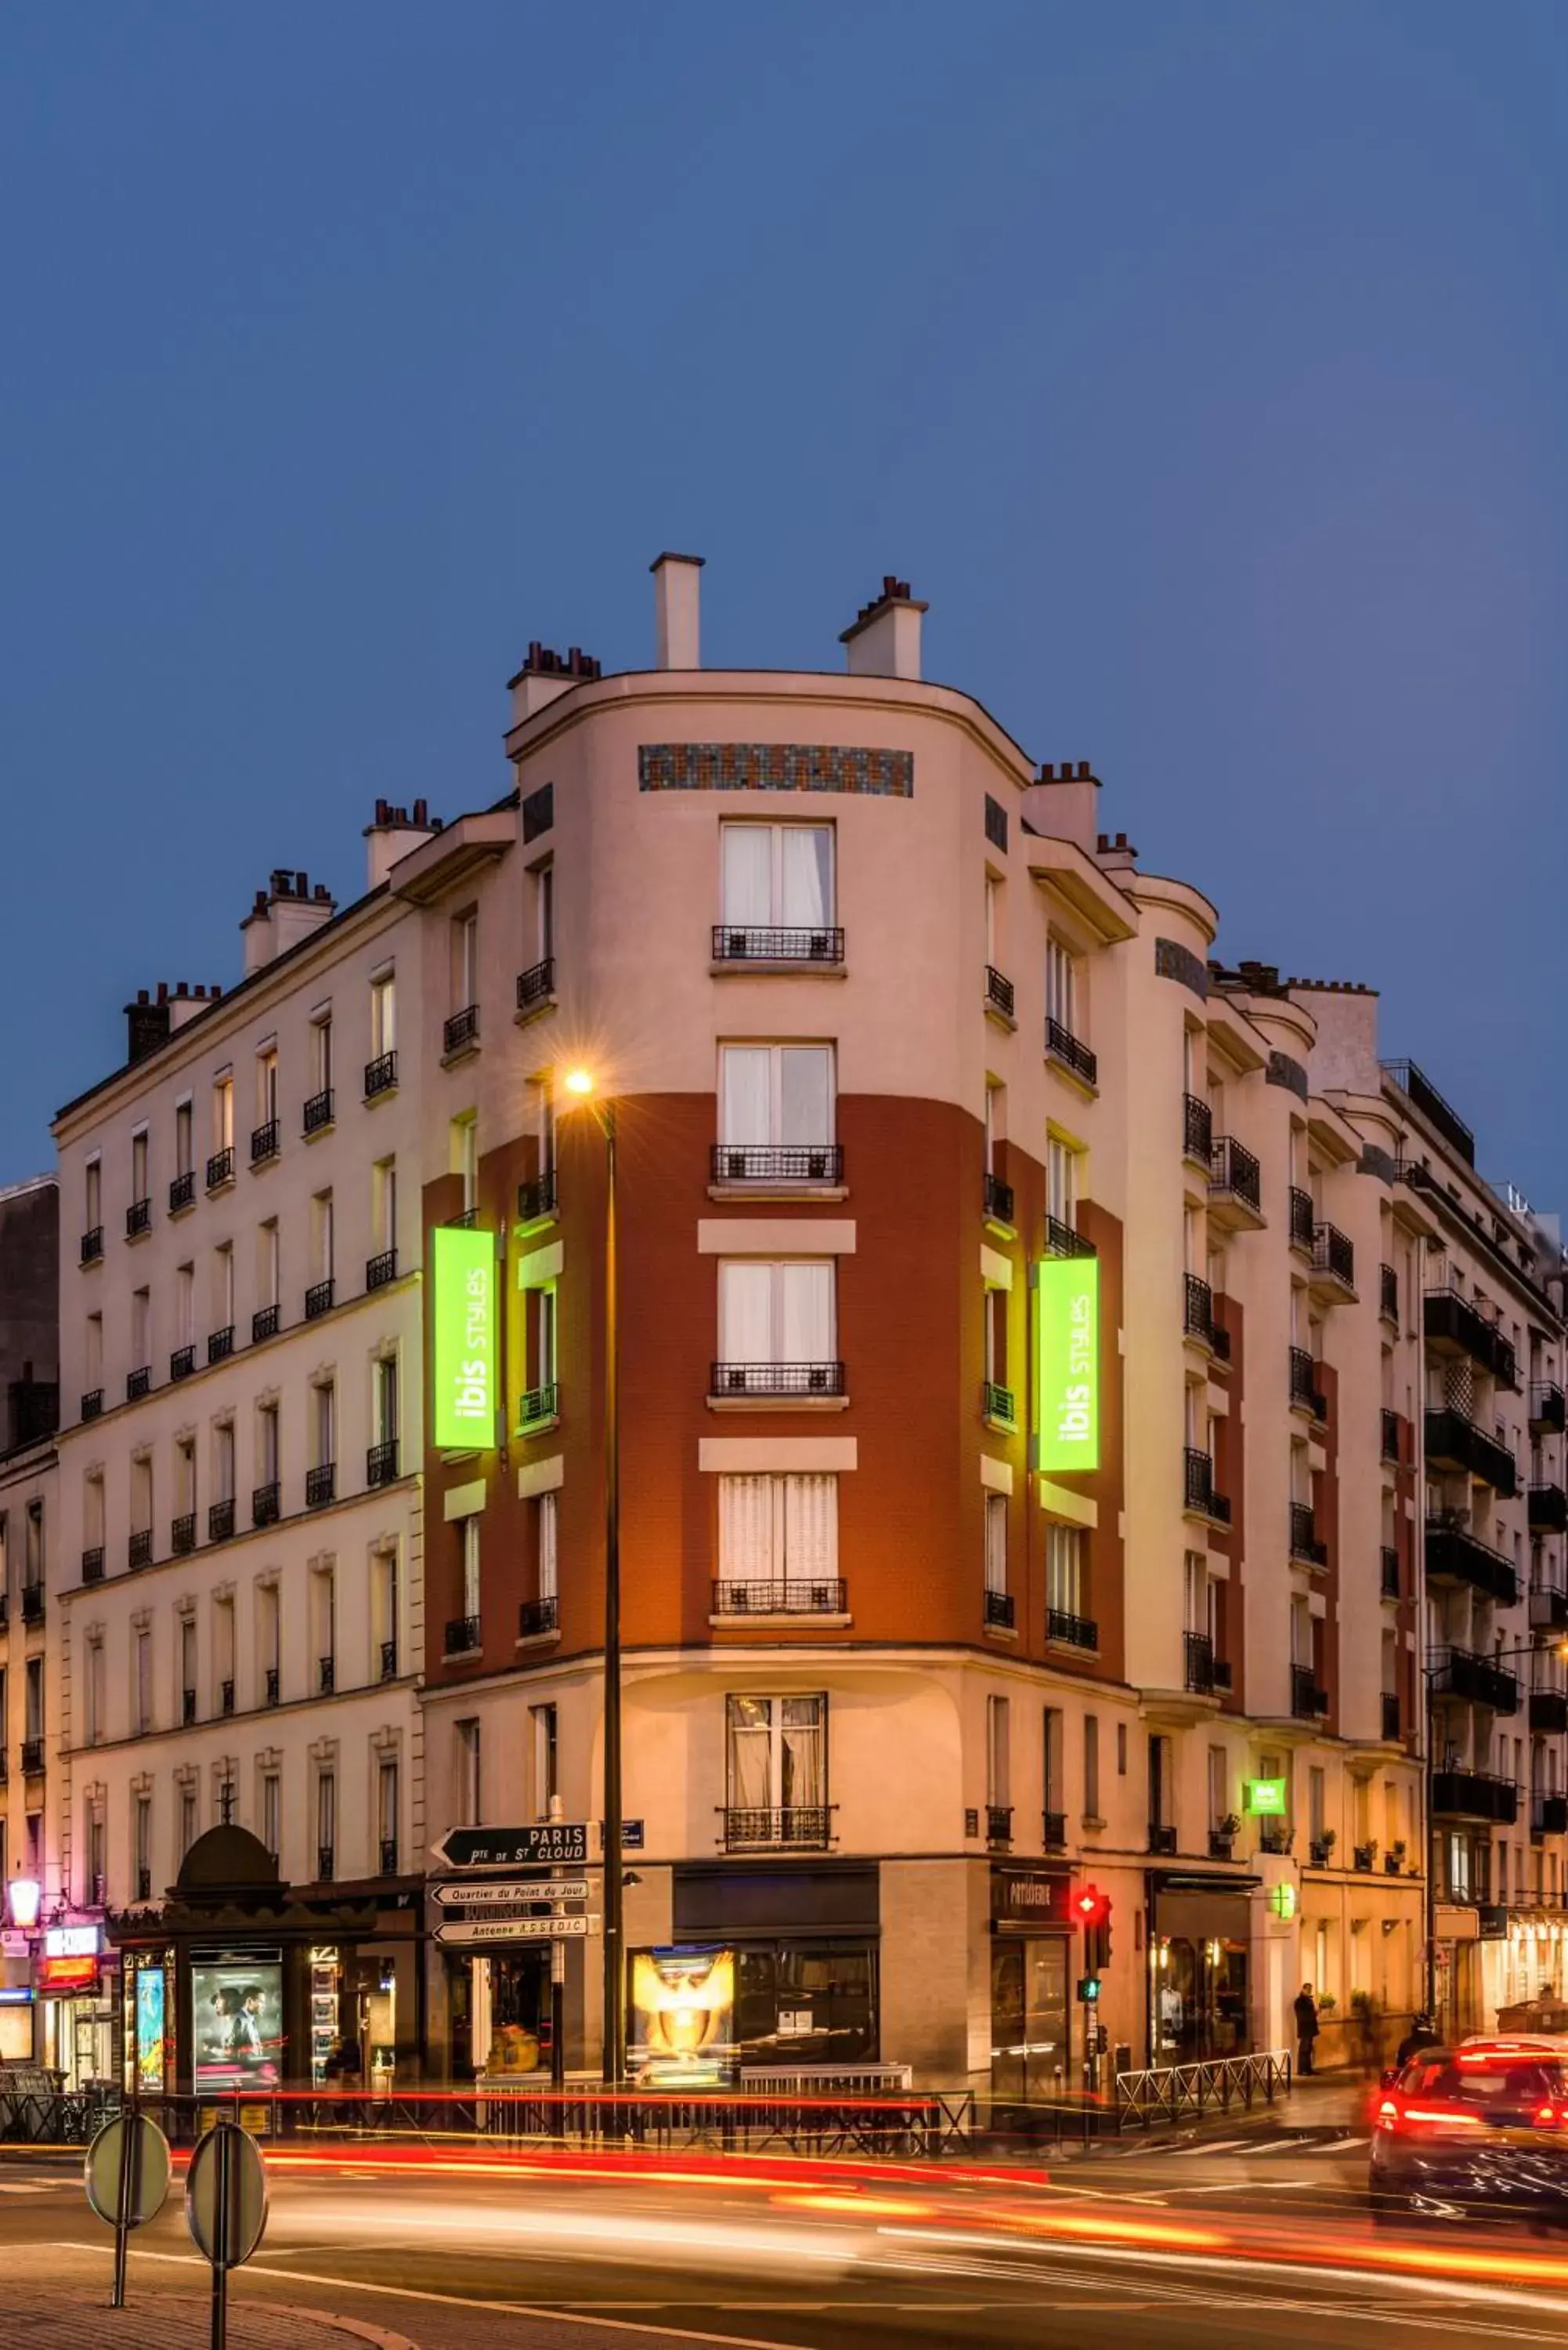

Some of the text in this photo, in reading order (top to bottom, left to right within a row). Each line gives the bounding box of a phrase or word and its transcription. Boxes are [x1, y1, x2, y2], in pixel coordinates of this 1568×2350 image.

[454, 1359, 487, 1417] ibis
[1058, 1384, 1089, 1441] ibis
[530, 1828, 583, 1846] PARIS
[537, 1845, 583, 1860] CLOUD
[452, 1884, 583, 1900] Quartier du Point du Jour
[471, 1925, 514, 1936] Antenne
